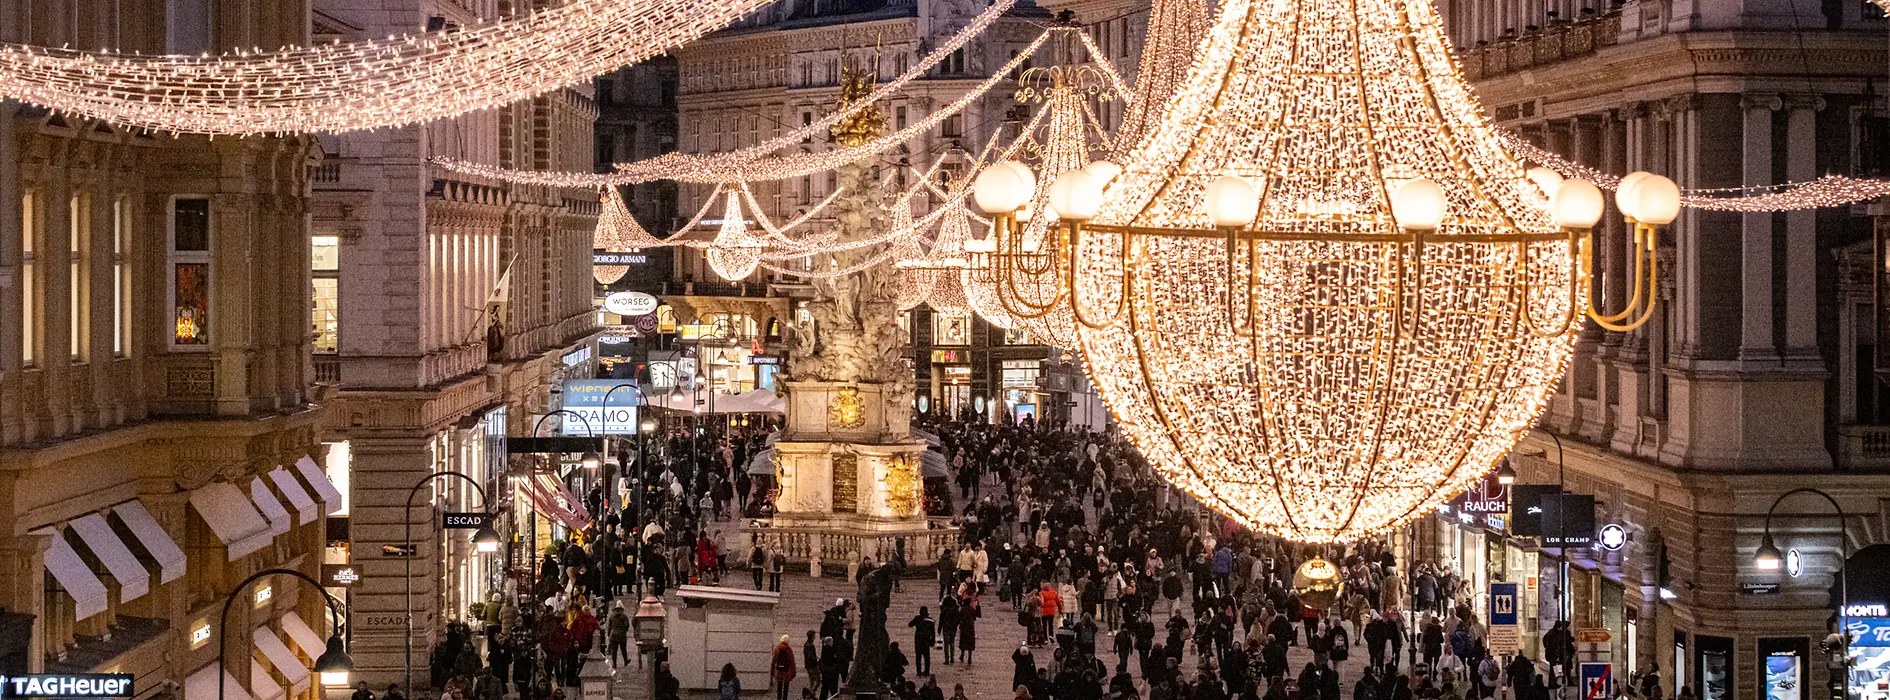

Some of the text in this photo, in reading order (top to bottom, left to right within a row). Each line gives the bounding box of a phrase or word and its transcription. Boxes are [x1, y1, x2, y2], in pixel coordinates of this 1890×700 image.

[620, 255, 646, 263] ARMANI
[569, 385, 630, 393] wienein
[569, 410, 630, 423] BRAMO
[1464, 501, 1506, 511] RAUCH
[447, 516, 486, 525] ESCAD
